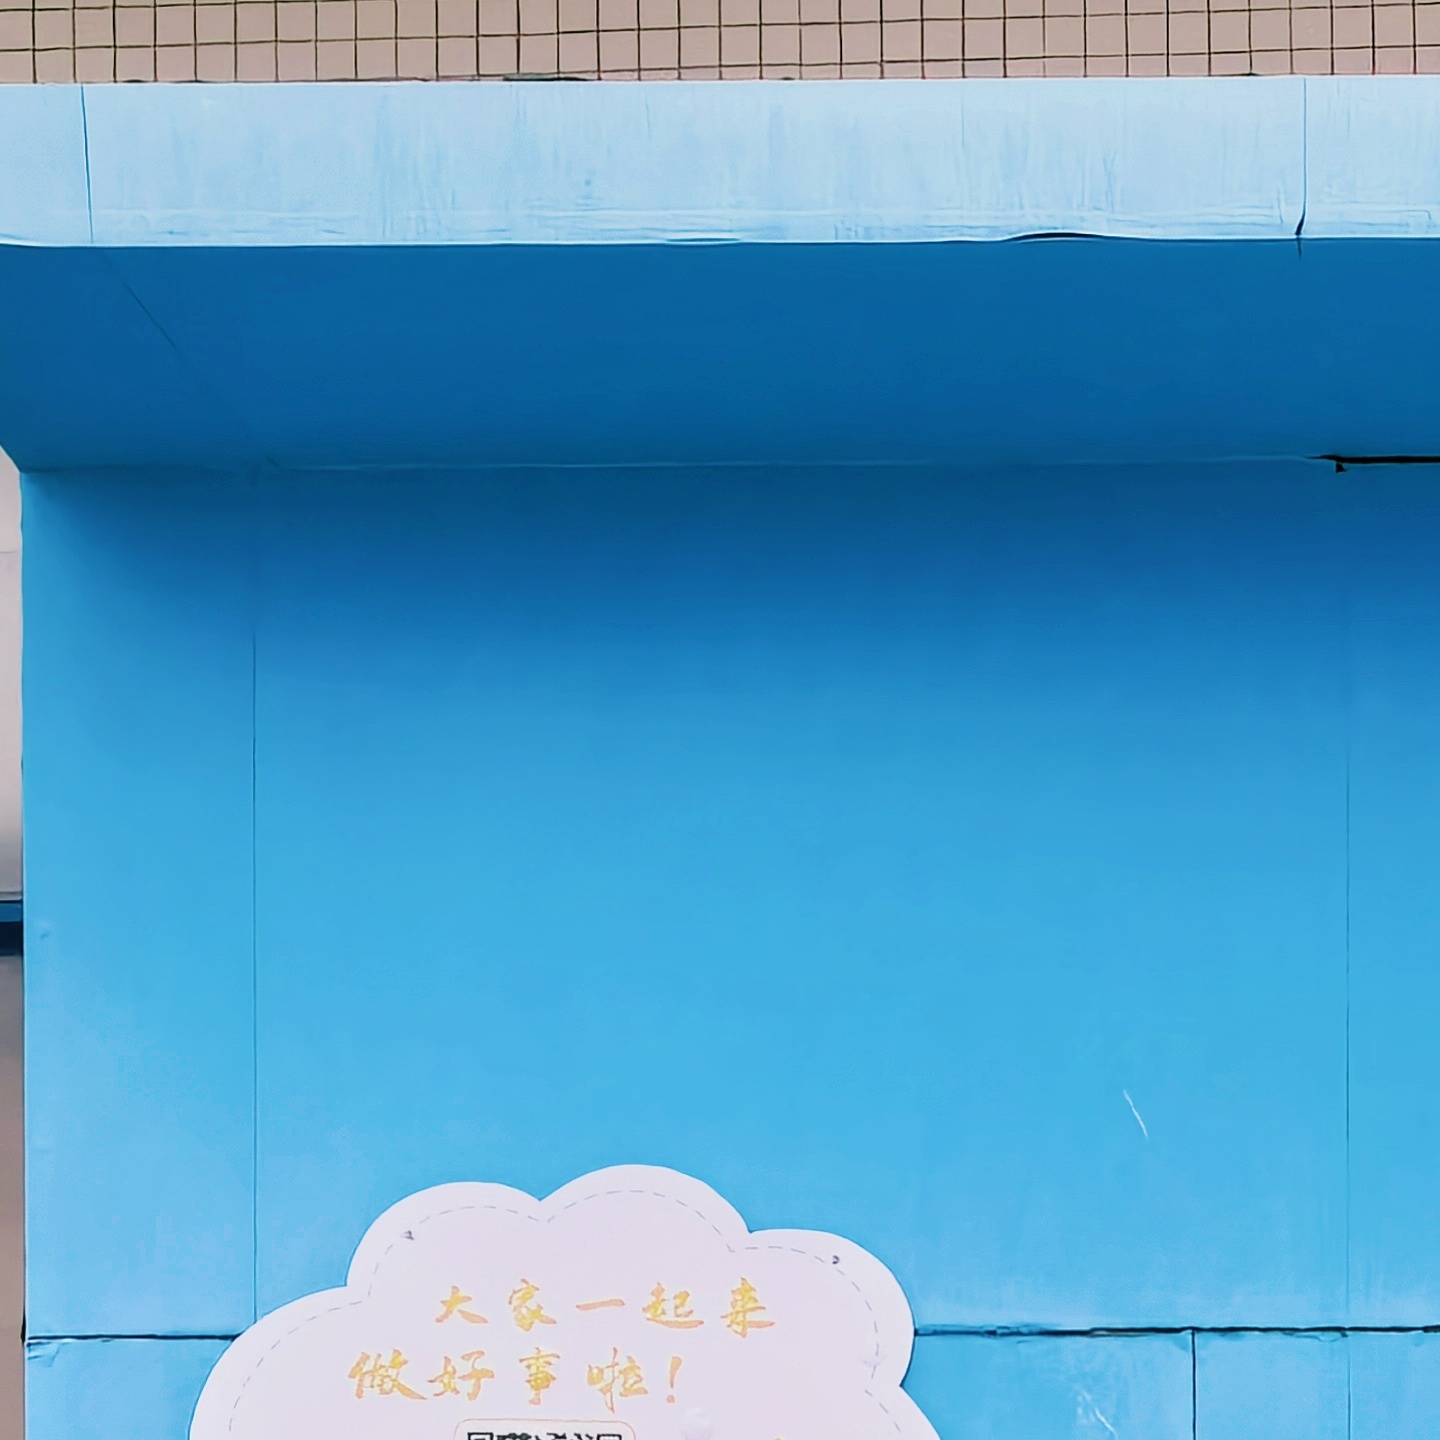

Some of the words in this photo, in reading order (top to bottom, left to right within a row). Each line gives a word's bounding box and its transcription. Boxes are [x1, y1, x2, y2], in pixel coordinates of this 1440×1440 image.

[434, 1276, 775, 1338] 大家一起来
